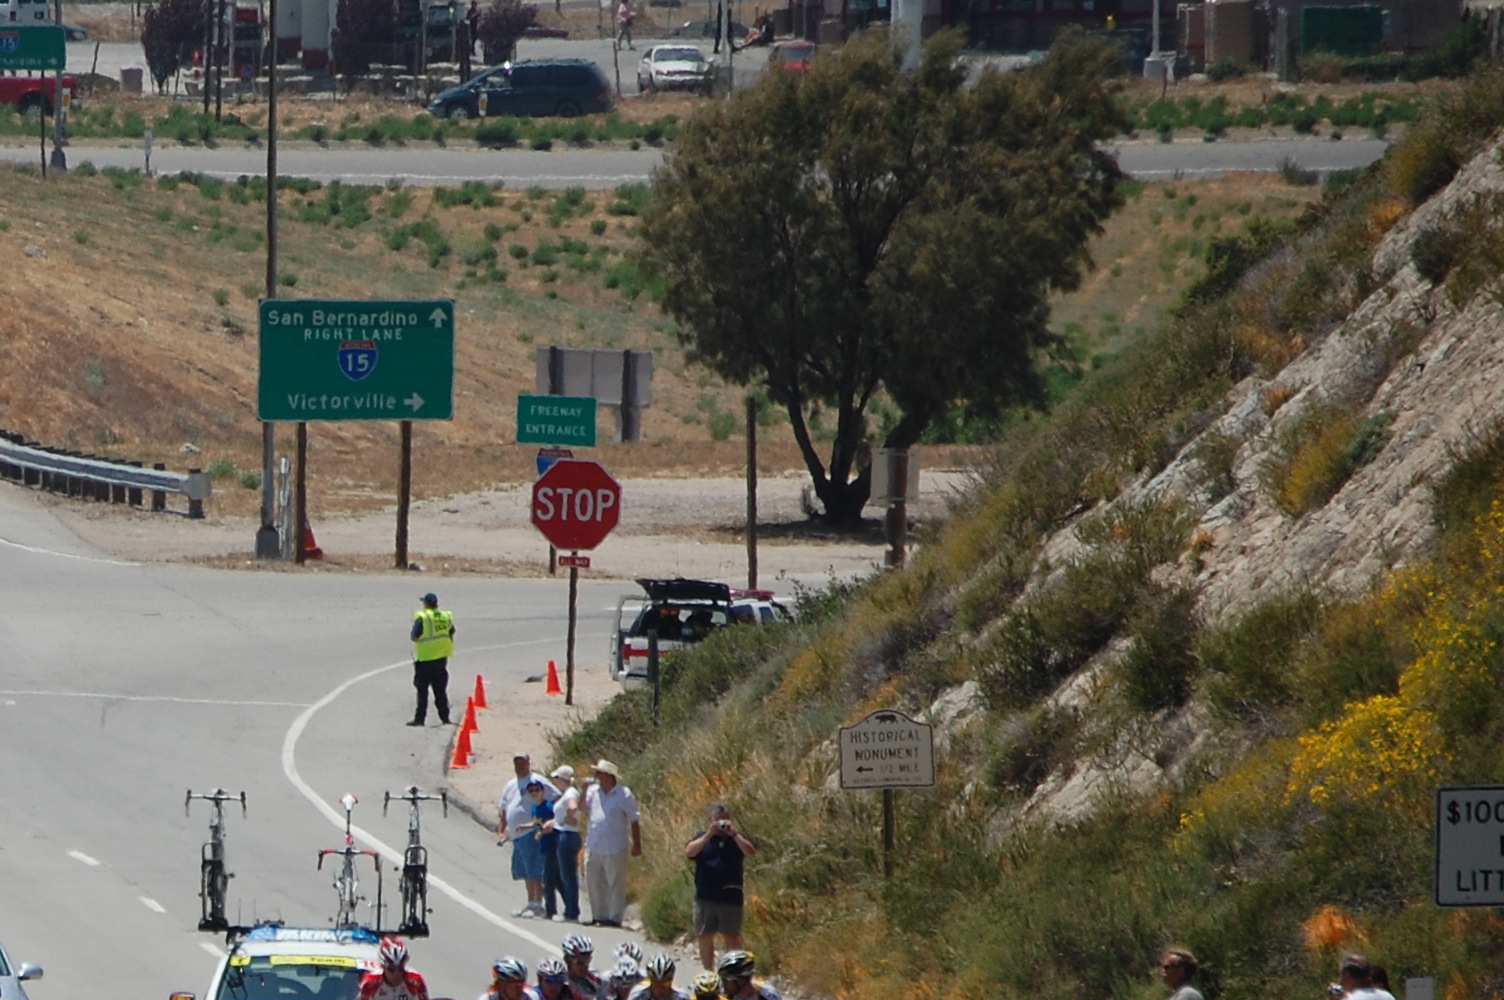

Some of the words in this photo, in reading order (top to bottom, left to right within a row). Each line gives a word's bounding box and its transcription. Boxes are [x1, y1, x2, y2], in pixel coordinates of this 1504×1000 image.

[3, 37, 15, 49] 15
[267, 309, 304, 326] San
[312, 309, 418, 327] Bernardino
[303, 327, 355, 342] RIGHT
[362, 327, 403, 341] LANE
[346, 353, 370, 373] 15
[287, 393, 397, 411] Victorville
[529, 404, 584, 418] FREEWAY
[525, 423, 587, 437] ENTRANCE
[536, 486, 615, 522] STOP
[850, 729, 922, 744] HISTORICAL
[854, 746, 920, 762] MONUMENT
[898, 763, 920, 773] MILE
